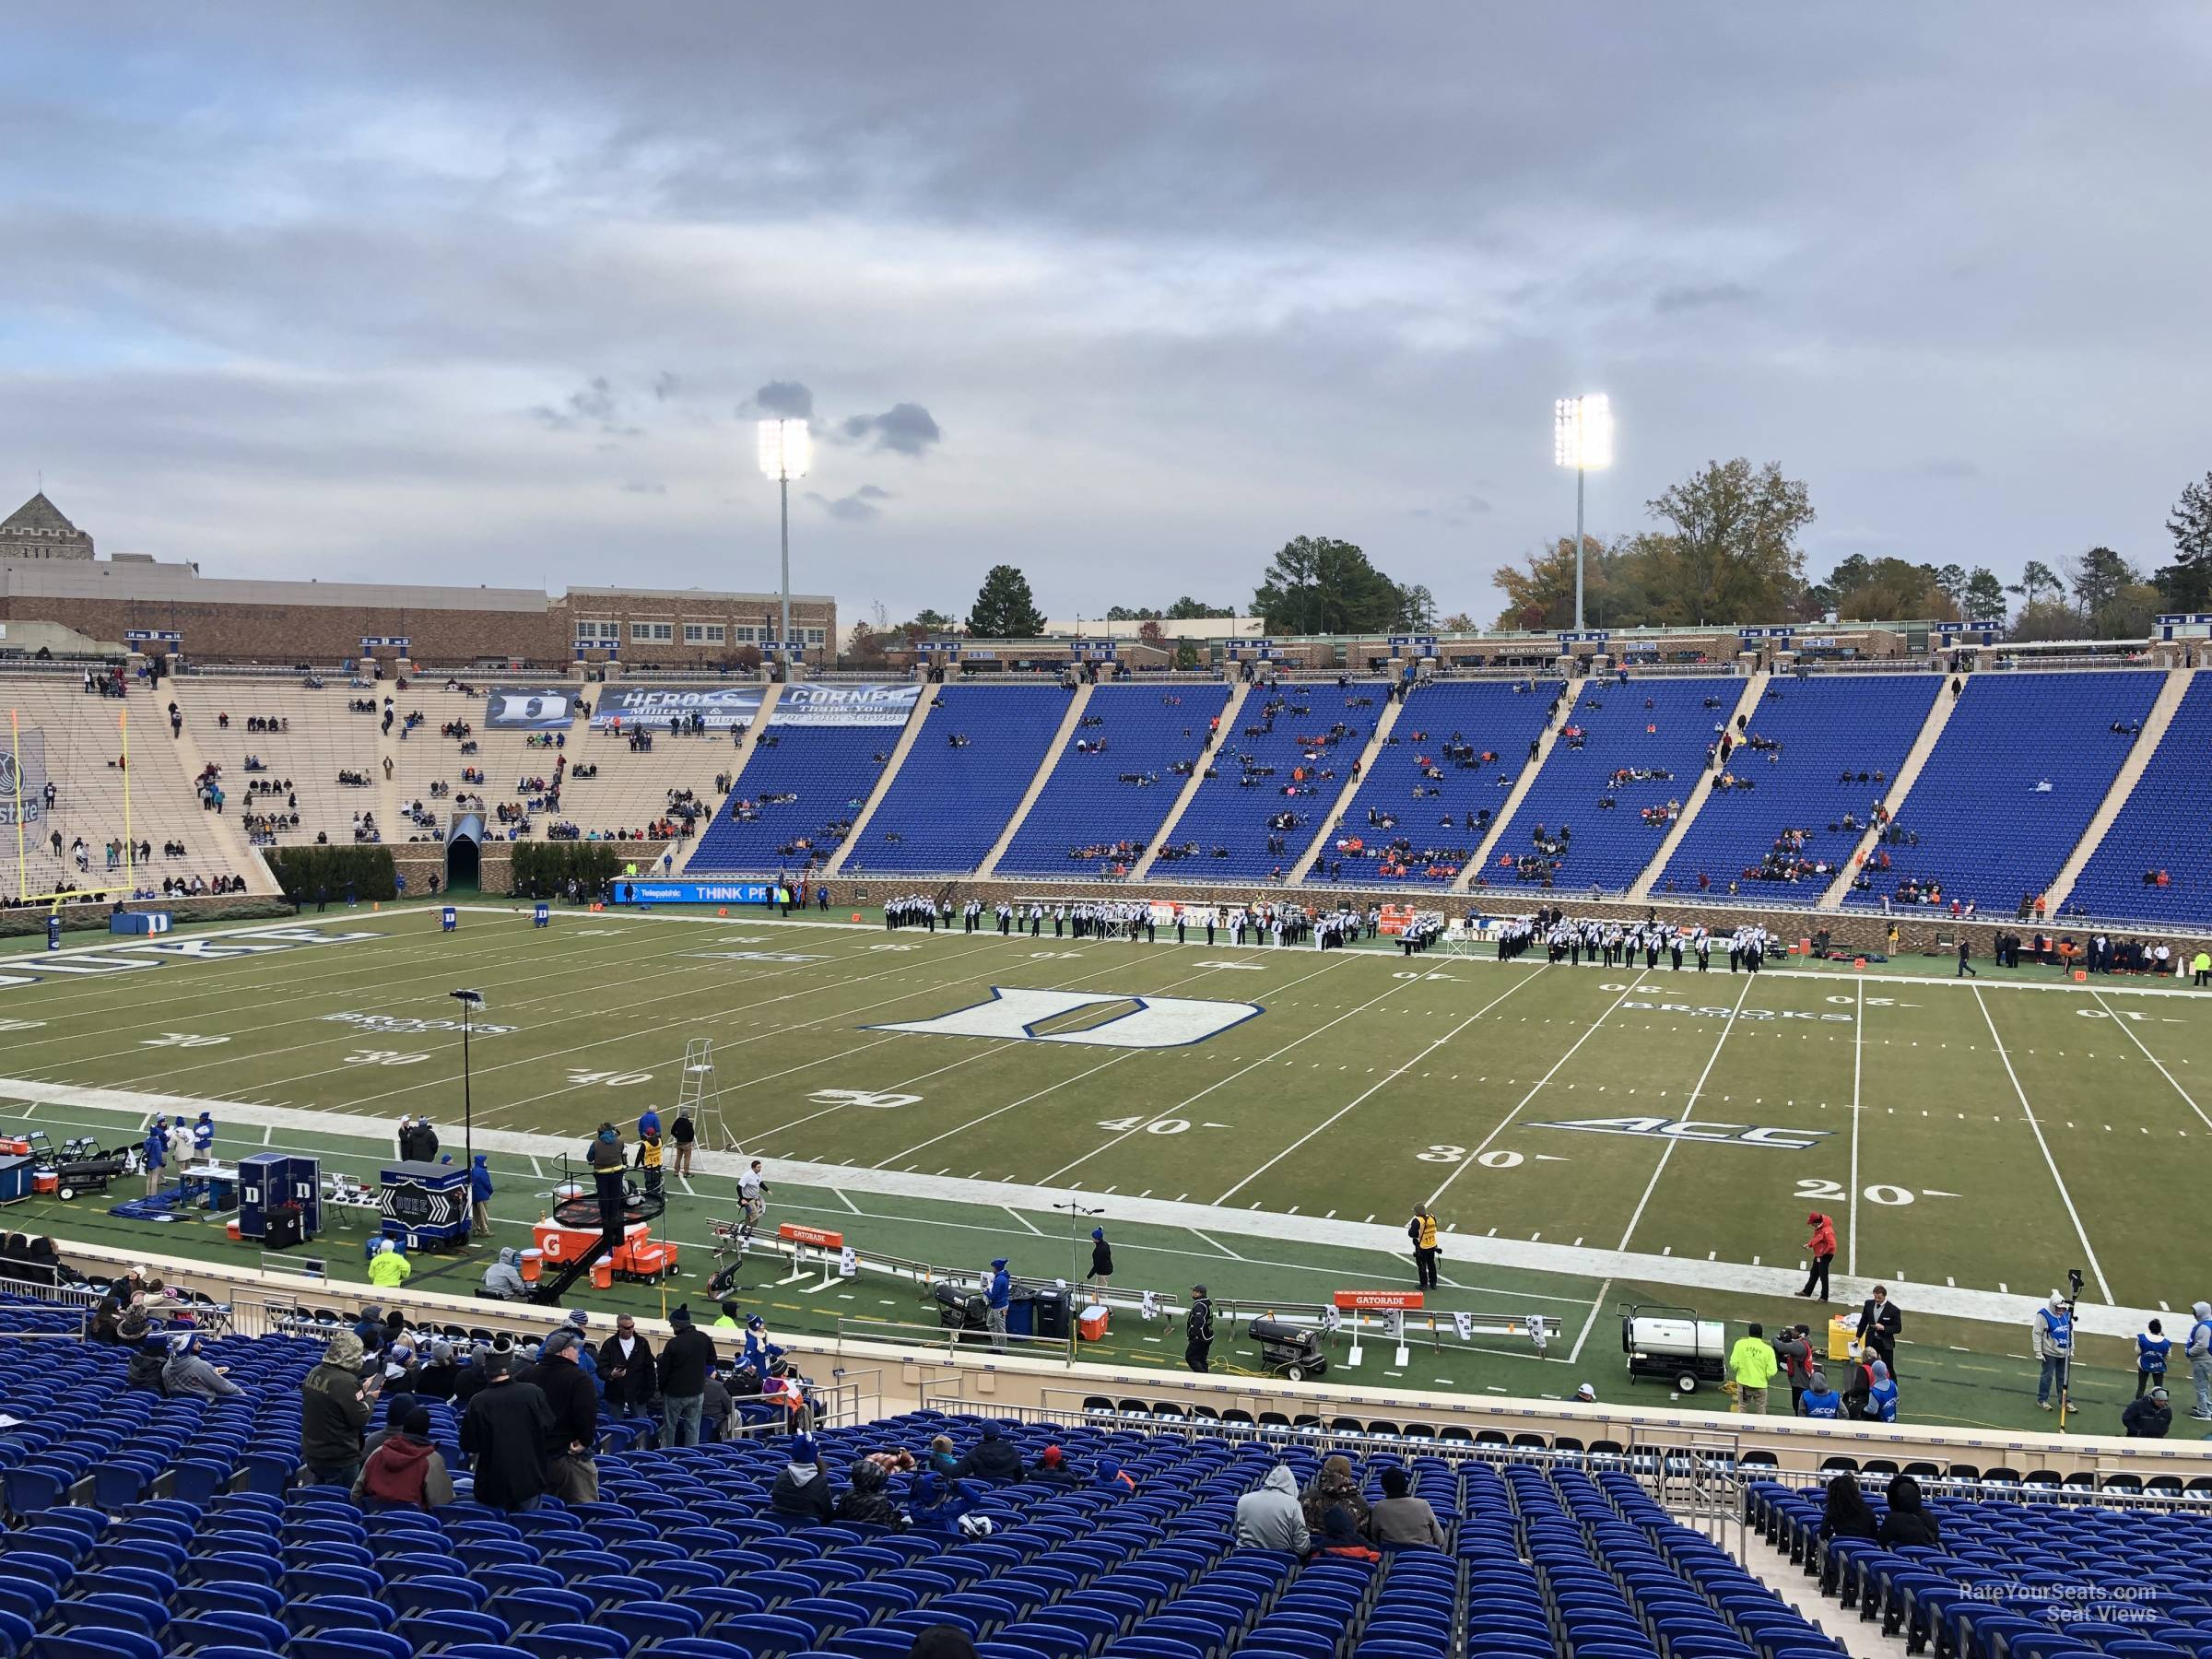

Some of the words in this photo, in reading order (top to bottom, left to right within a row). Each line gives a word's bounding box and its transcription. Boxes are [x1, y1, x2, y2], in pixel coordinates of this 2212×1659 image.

[622, 692, 739, 707] HEROES
[789, 690, 906, 705] CORNER
[629, 706, 694, 716] Military
[709, 707, 724, 715] &
[774, 713, 800, 722] For
[805, 713, 842, 722] Your
[847, 713, 906, 722] Service
[696, 887, 744, 900] THINK
[445, 912, 455, 923] D
[537, 909, 547, 918] D
[147, 914, 168, 934] D
[1392, 971, 1455, 981] 40
[1598, 983, 1663, 994] 30
[1825, 994, 1895, 1006] 20
[856, 986, 1266, 1048] D
[1618, 1001, 1855, 1022] BROOKS
[2075, 1009, 2155, 1021] 10
[321, 1013, 520, 1034] BROOKS
[139, 1033, 232, 1047] 20
[343, 1050, 431, 1065] 30
[566, 1071, 653, 1086] 40
[806, 1088, 924, 1109] 50
[1096, 1115, 1191, 1135] 40
[1516, 1116, 1840, 1150] ACC
[1415, 1144, 1525, 1170] 30
[244, 1186, 259, 1204] D
[296, 1182, 311, 1199] D
[1793, 1179, 1915, 1206] 20
[395, 1195, 428, 1213] DUKE
[265, 1221, 273, 1230] G
[288, 1218, 295, 1229] G
[406, 1233, 418, 1248] D
[793, 1230, 826, 1242] GATORADE
[542, 1233, 560, 1256] G
[1356, 1296, 1405, 1306] GATORADE
[1745, 1346, 1762, 1355] STAFF
[305, 1371, 330, 1394] U.S.A.
